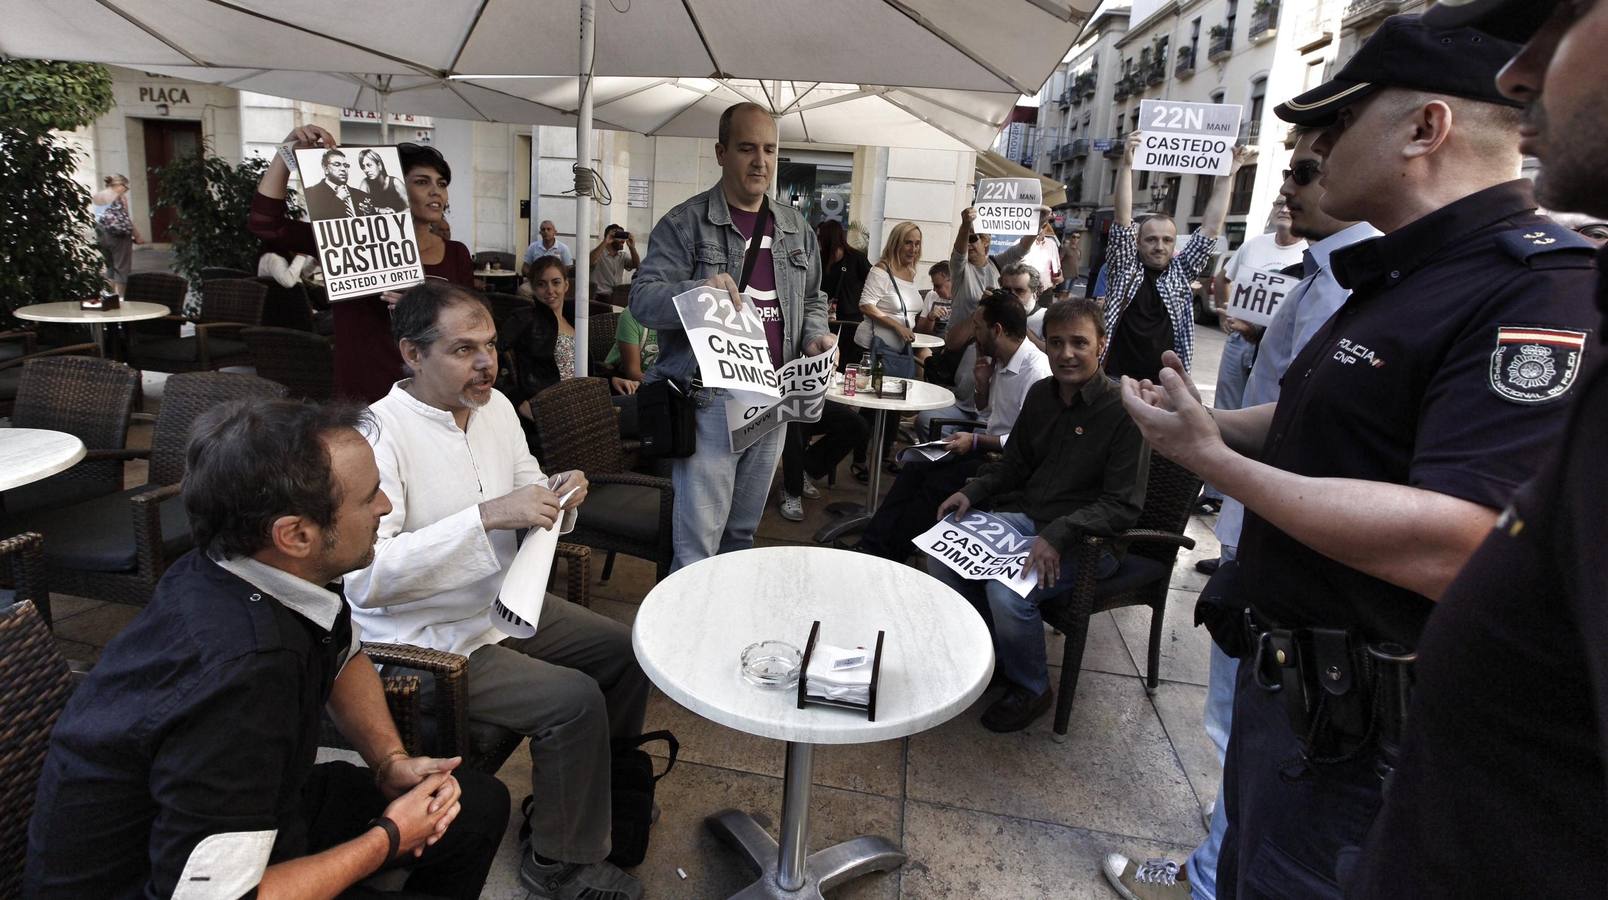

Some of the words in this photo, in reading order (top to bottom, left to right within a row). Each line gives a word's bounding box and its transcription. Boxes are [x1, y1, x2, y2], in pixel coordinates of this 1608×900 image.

[139, 87, 190, 105] PLAÇA
[1151, 106, 1204, 130] 22N
[1206, 123, 1231, 131] MANI
[1146, 136, 1226, 154] CASTEDO
[1146, 153, 1220, 170] DIMISIÓN
[983, 182, 1018, 200] 22N
[1019, 193, 1036, 201] MANI
[978, 206, 1033, 218] CASTEDO
[319, 215, 390, 250] JUICIO
[393, 214, 406, 240] Y
[982, 218, 1030, 231] DIMISIÓN
[324, 239, 417, 277] CASTIGO
[330, 275, 378, 293] CASTEDO
[380, 274, 388, 284] Y
[390, 269, 419, 283] ORTIZ
[1252, 272, 1285, 285] PP
[708, 335, 773, 364] CAST
[1333, 351, 1357, 364] CNP
[719, 360, 777, 389] DIMIS
[1495, 380, 1544, 399] NACIONAL
[777, 397, 824, 422] 2N
[744, 412, 771, 435] MANI
[960, 514, 1028, 553] 22N
